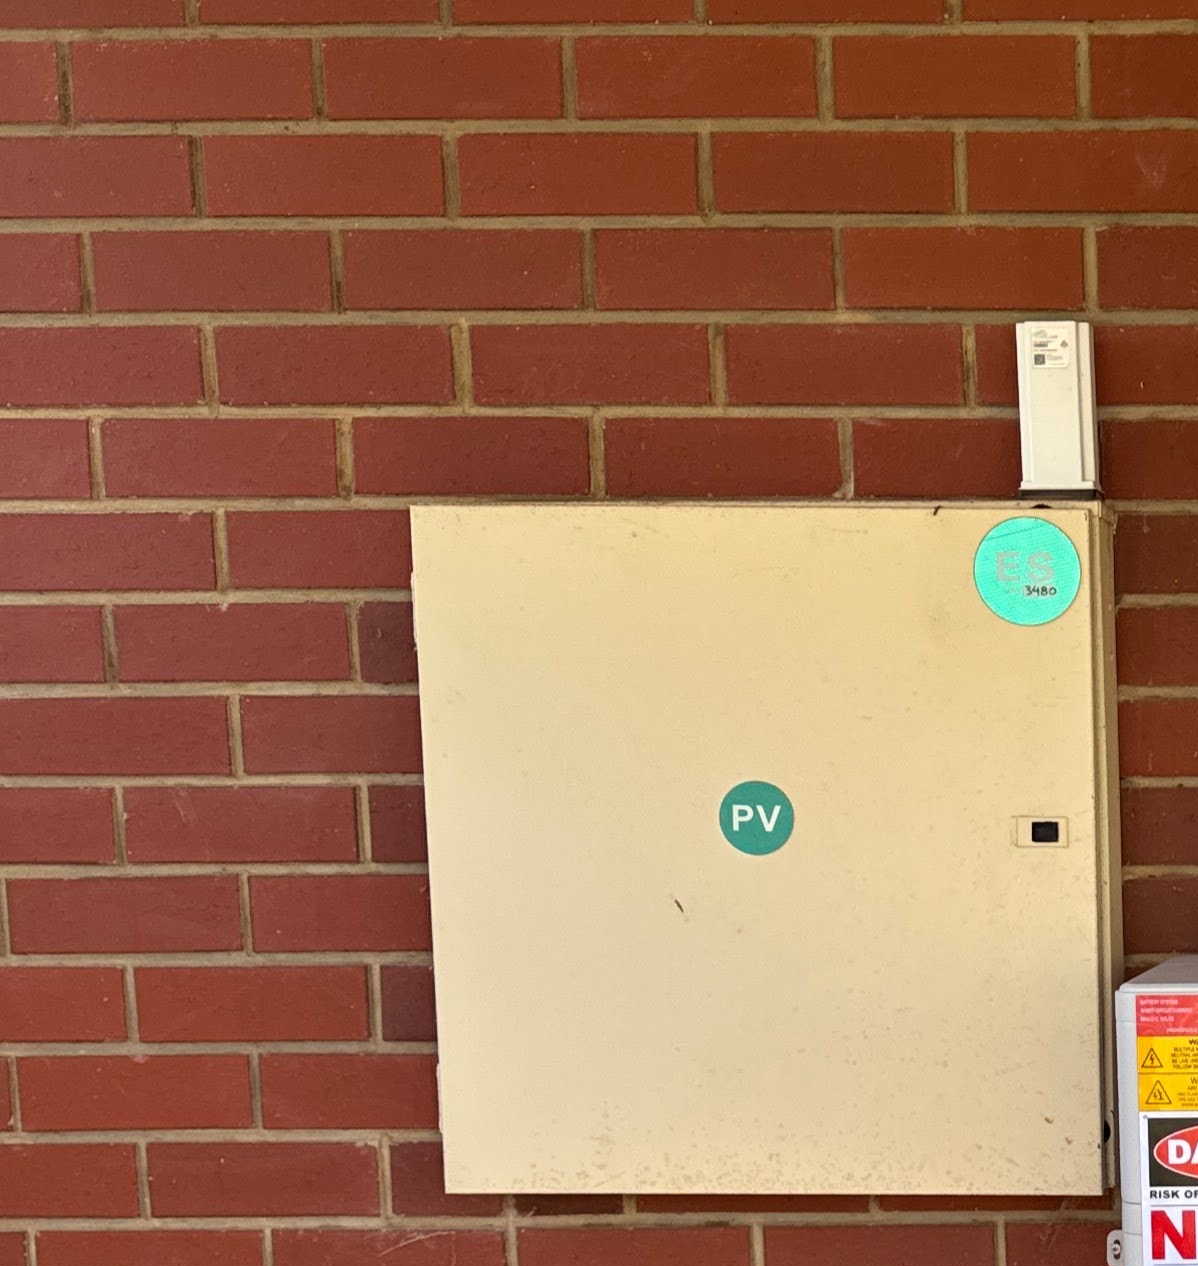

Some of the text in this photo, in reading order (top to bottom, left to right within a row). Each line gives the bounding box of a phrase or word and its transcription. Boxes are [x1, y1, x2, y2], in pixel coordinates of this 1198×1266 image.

[996, 551, 1055, 582] ES
[1024, 585, 1057, 596] 3480
[732, 804, 781, 832] PV
[1150, 1189, 1180, 1199] RISK
